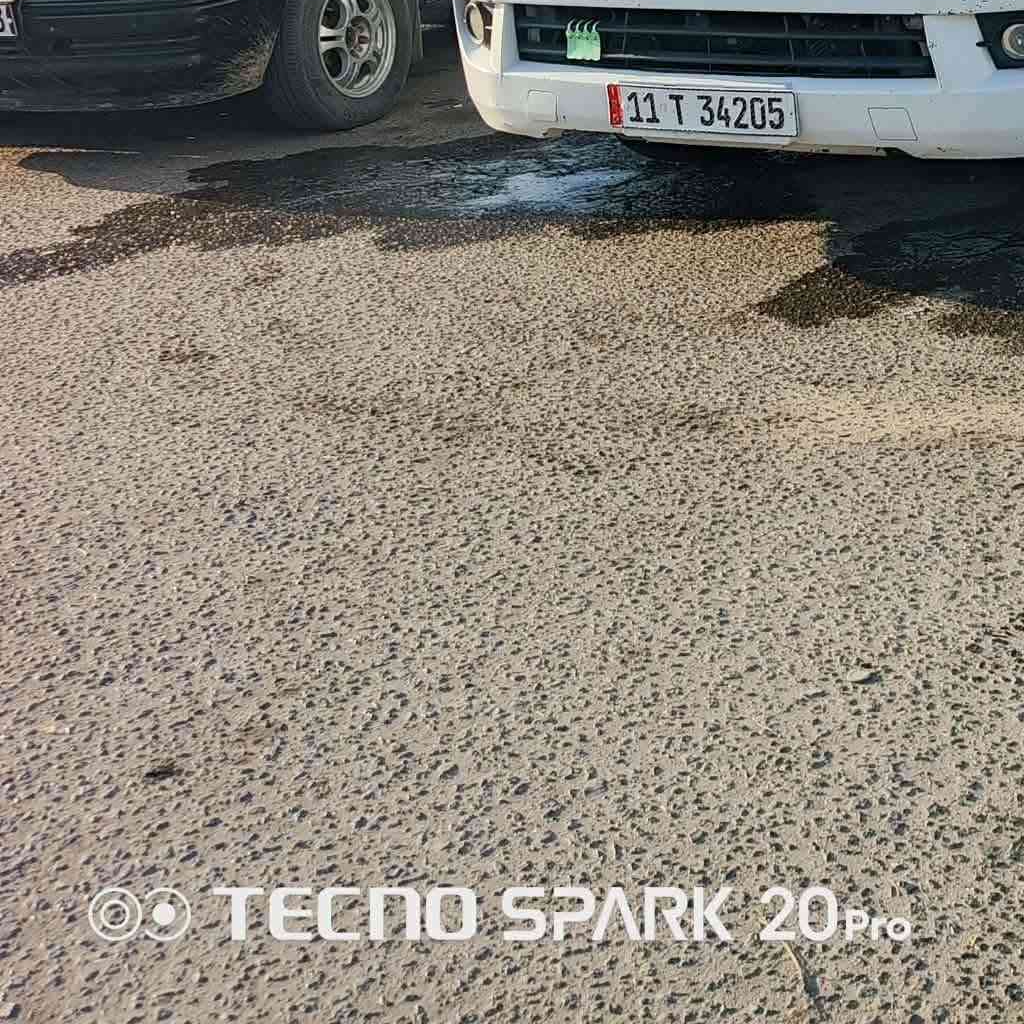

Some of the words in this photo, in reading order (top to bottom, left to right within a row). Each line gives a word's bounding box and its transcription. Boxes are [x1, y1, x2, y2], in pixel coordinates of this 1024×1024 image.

[627, 91, 660, 123] 11
[668, 94, 684, 125] T
[696, 95, 785, 130] 34205
